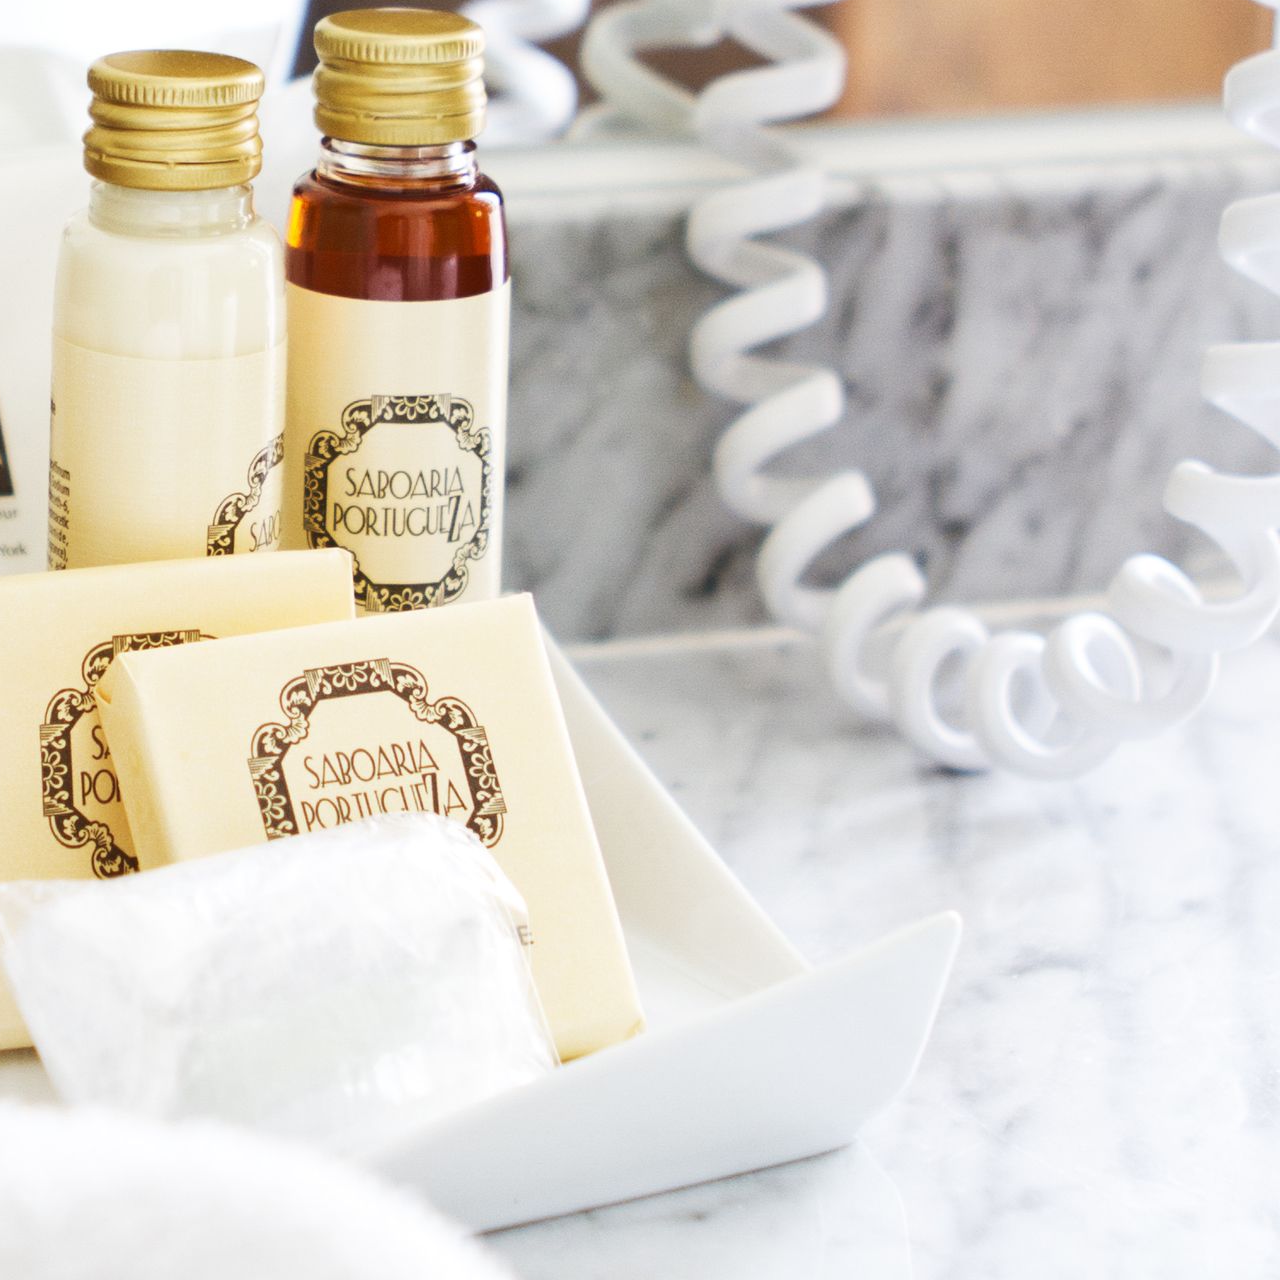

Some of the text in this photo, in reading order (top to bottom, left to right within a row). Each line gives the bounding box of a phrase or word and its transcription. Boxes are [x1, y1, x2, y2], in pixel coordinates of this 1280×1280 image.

[344, 465, 465, 500] SABOARIA
[332, 494, 476, 544] PORTUGUEZA
[303, 738, 441, 790] SABOARIA
